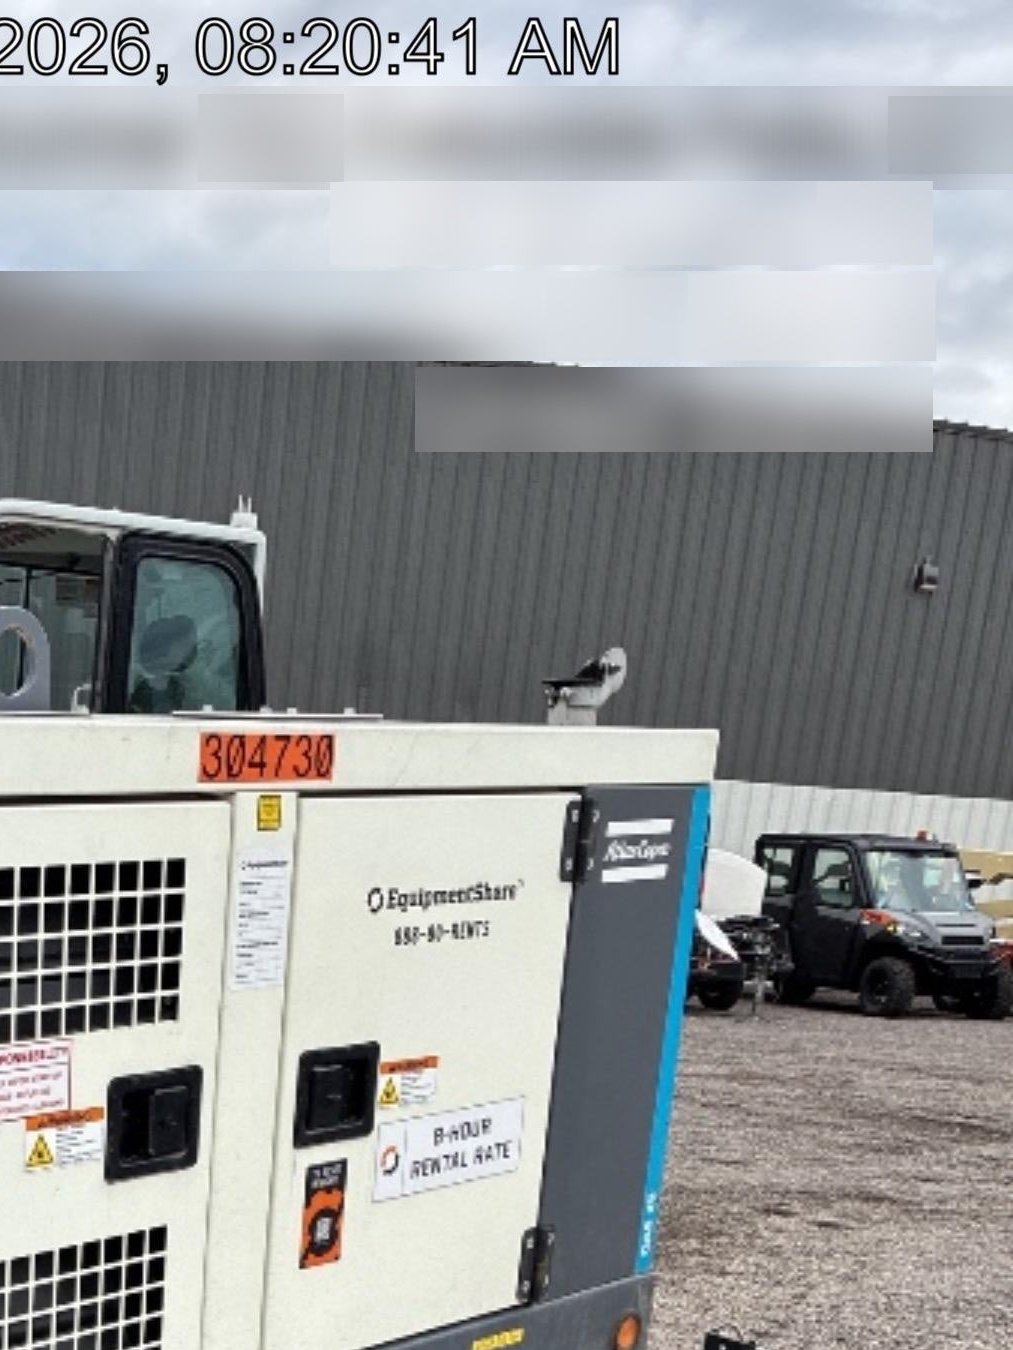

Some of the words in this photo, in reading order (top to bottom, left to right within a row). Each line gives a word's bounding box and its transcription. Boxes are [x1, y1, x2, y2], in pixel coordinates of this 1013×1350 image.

[202, 734, 334, 779] 304730
[409, 1151, 468, 1179] RENTAL
[473, 1140, 513, 1165] RATE
